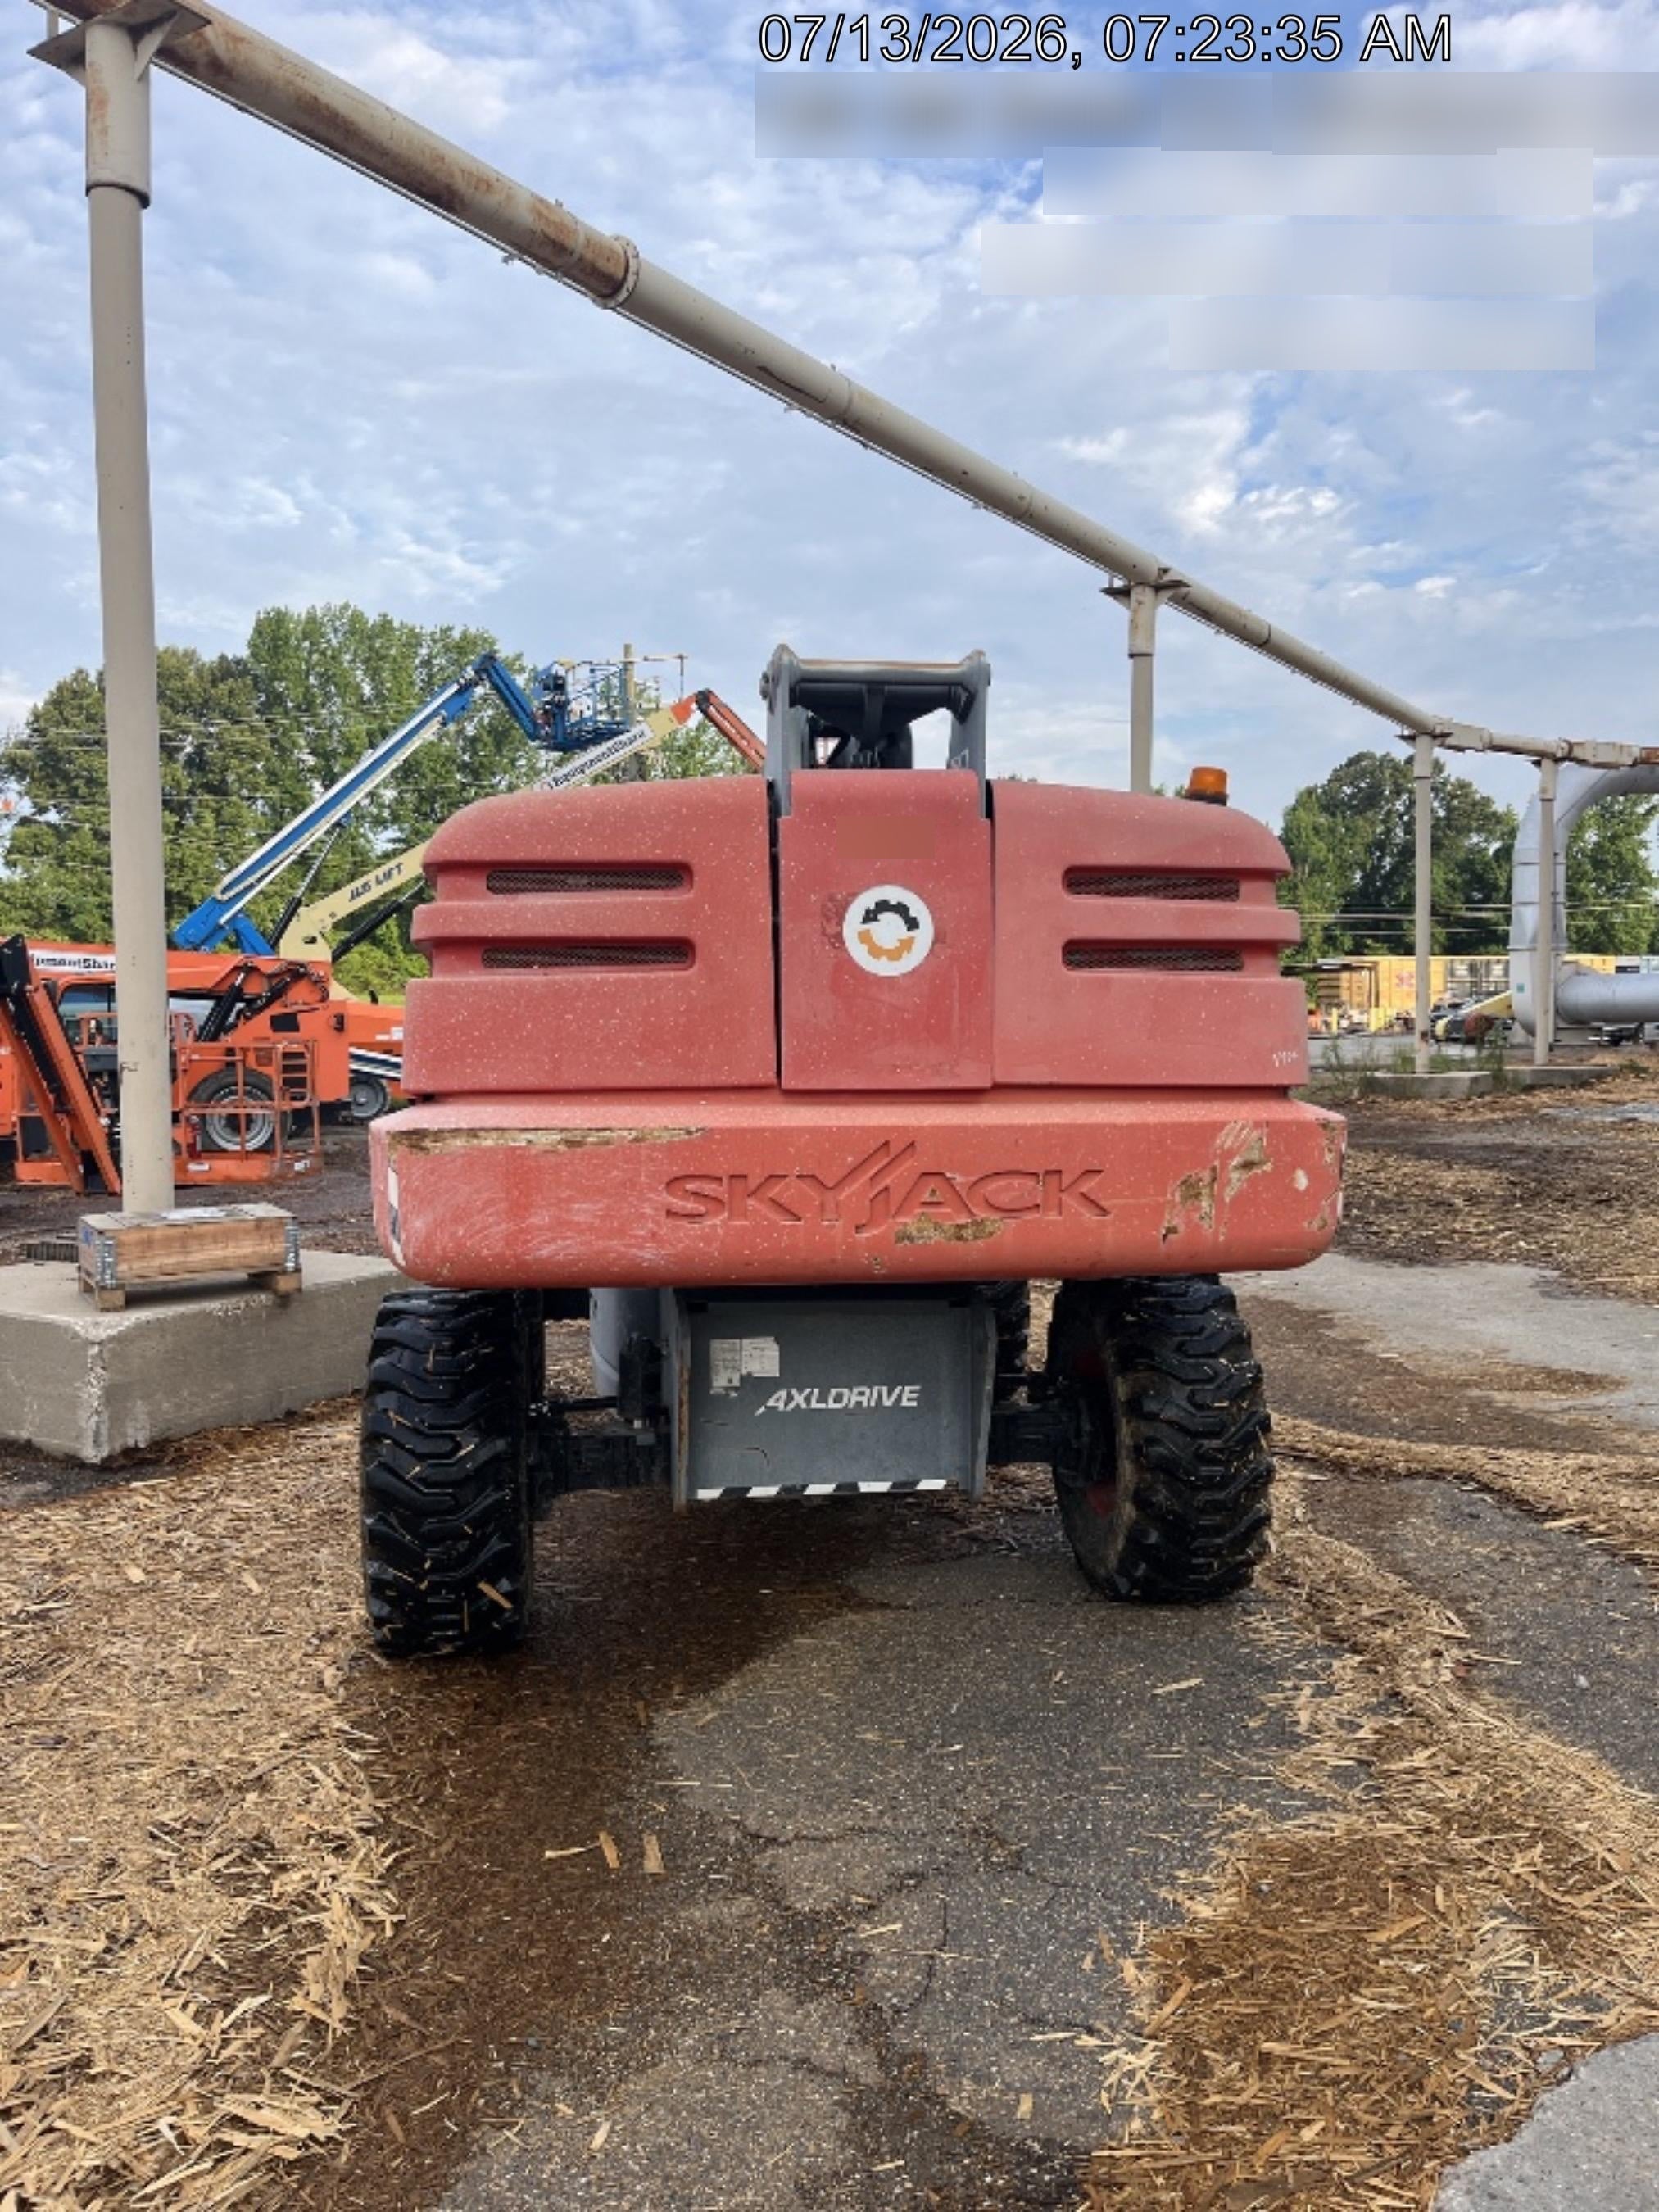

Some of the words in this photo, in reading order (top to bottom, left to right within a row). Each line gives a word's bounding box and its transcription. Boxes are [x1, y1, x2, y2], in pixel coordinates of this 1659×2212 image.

[375, 863, 403, 885] LIFT
[665, 1140, 1112, 1235] SKYJACK
[754, 1385, 921, 1416] AXLDRIVE
